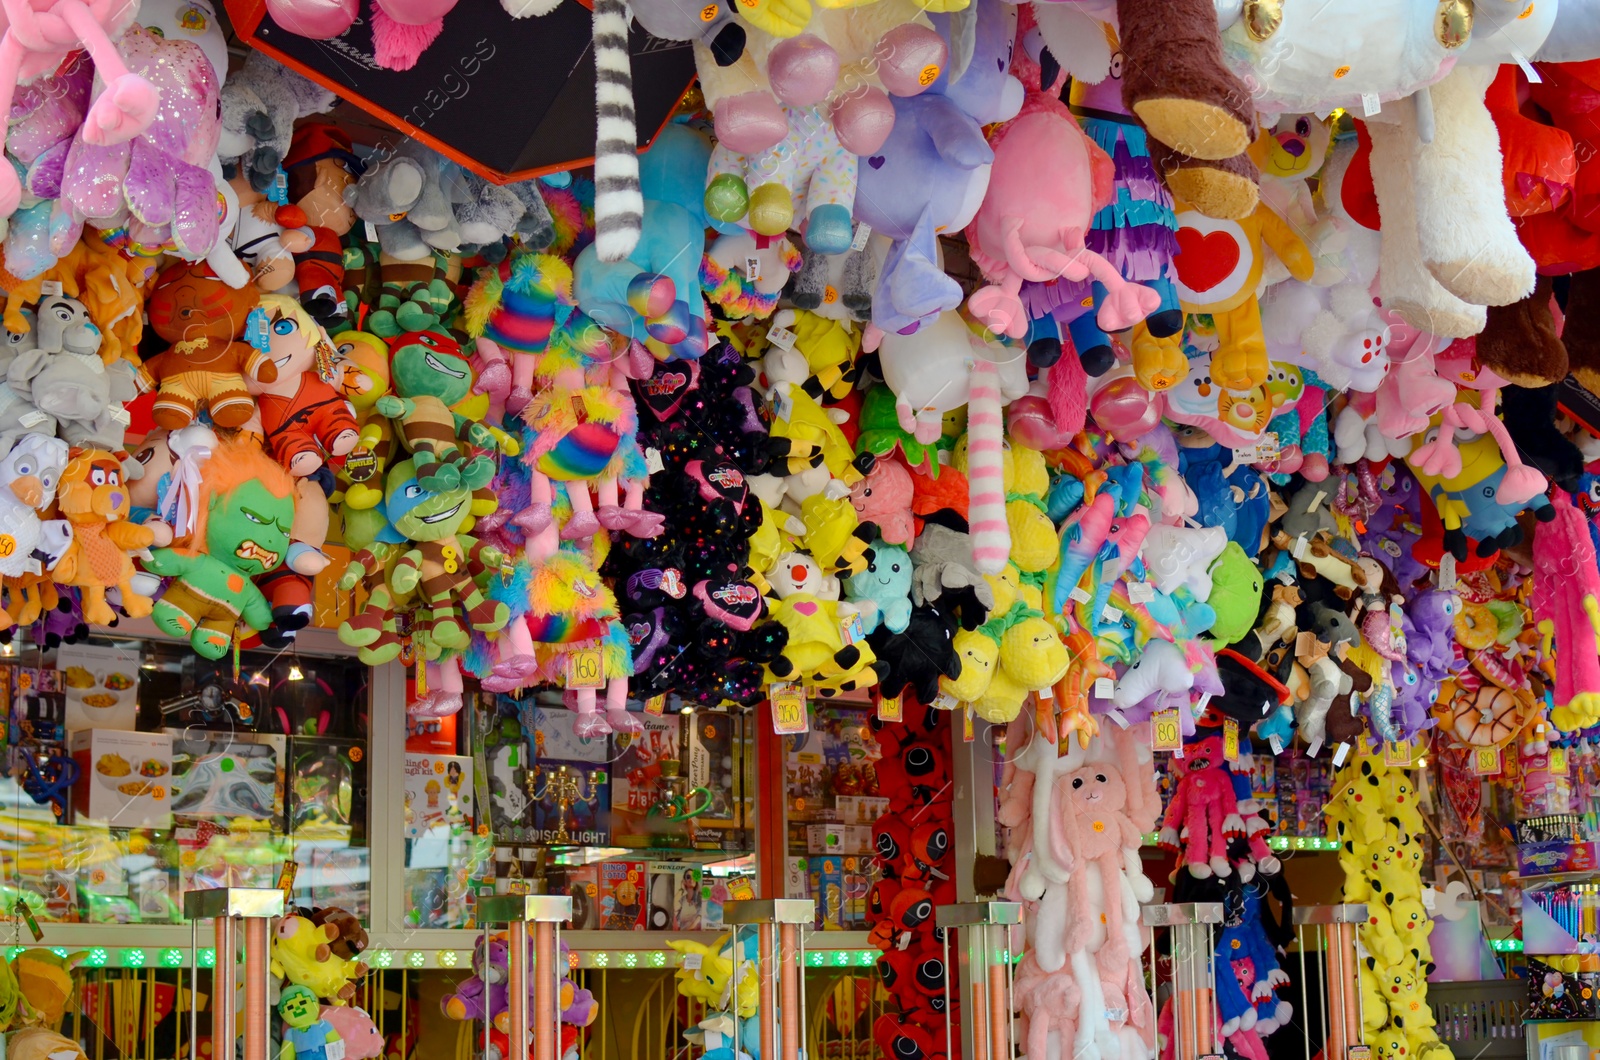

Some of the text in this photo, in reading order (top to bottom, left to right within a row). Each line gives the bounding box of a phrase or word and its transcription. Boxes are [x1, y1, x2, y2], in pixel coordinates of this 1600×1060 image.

[575, 654, 597, 678] 160
[643, 721, 669, 730] Game
[1158, 723, 1176, 741] 80
[1480, 752, 1494, 769] 80
[630, 794, 637, 805] 7
[641, 796, 647, 806] 8
[532, 829, 606, 843] DISC LIGHT
